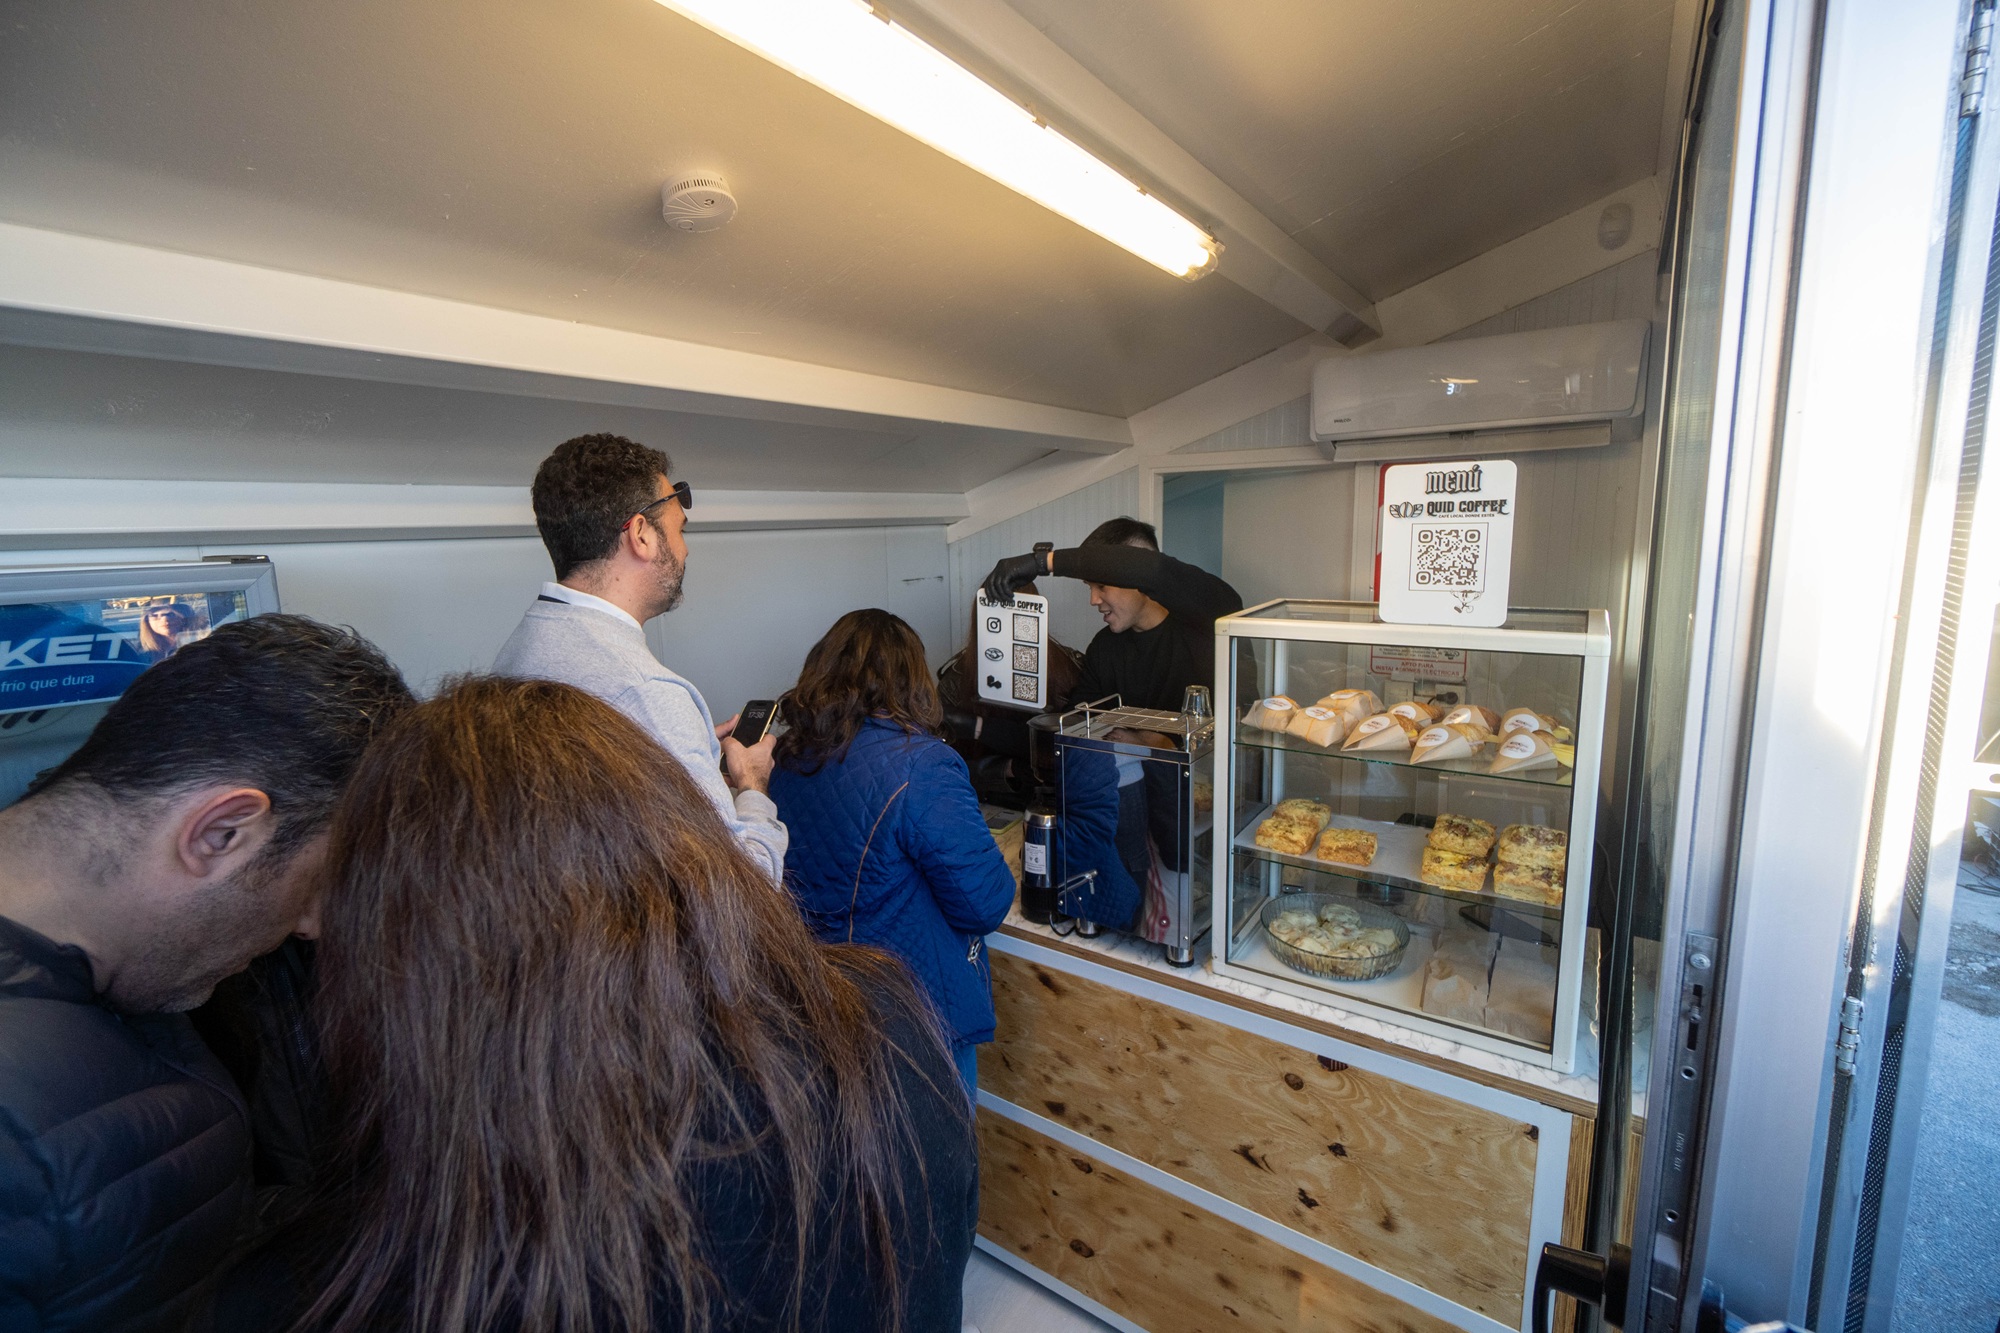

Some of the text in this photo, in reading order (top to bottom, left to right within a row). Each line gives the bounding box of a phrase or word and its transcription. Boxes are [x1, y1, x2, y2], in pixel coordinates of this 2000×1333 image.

[1427, 499, 1510, 517] QUID COFFEE
[1017, 600, 1045, 614] COFFEE
[30, 678, 58, 691] que
[62, 674, 95, 687] dura
